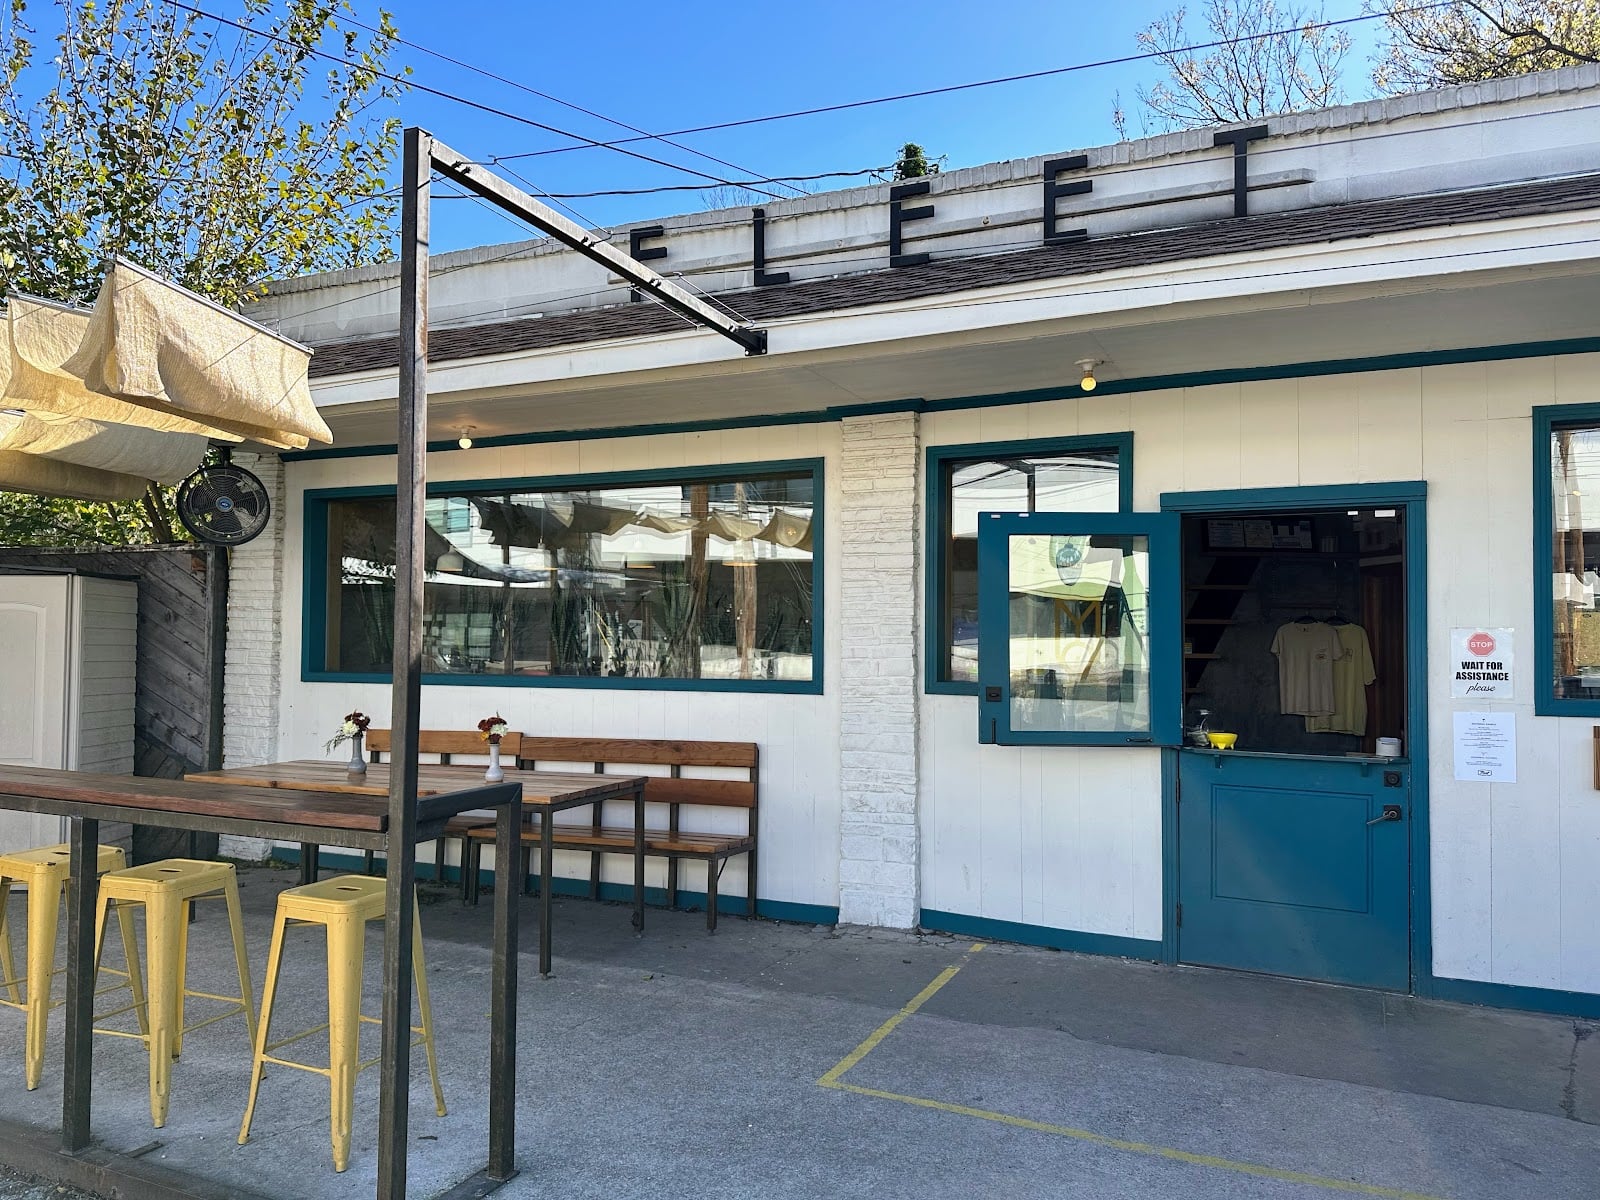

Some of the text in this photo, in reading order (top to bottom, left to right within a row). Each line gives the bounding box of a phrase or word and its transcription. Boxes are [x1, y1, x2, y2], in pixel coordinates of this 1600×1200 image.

[629, 124, 1269, 302] FLEET
[1461, 661, 1503, 670] WAIT FOR
[1455, 671, 1509, 681] ASSISTANCE
[1465, 682, 1496, 695] please
